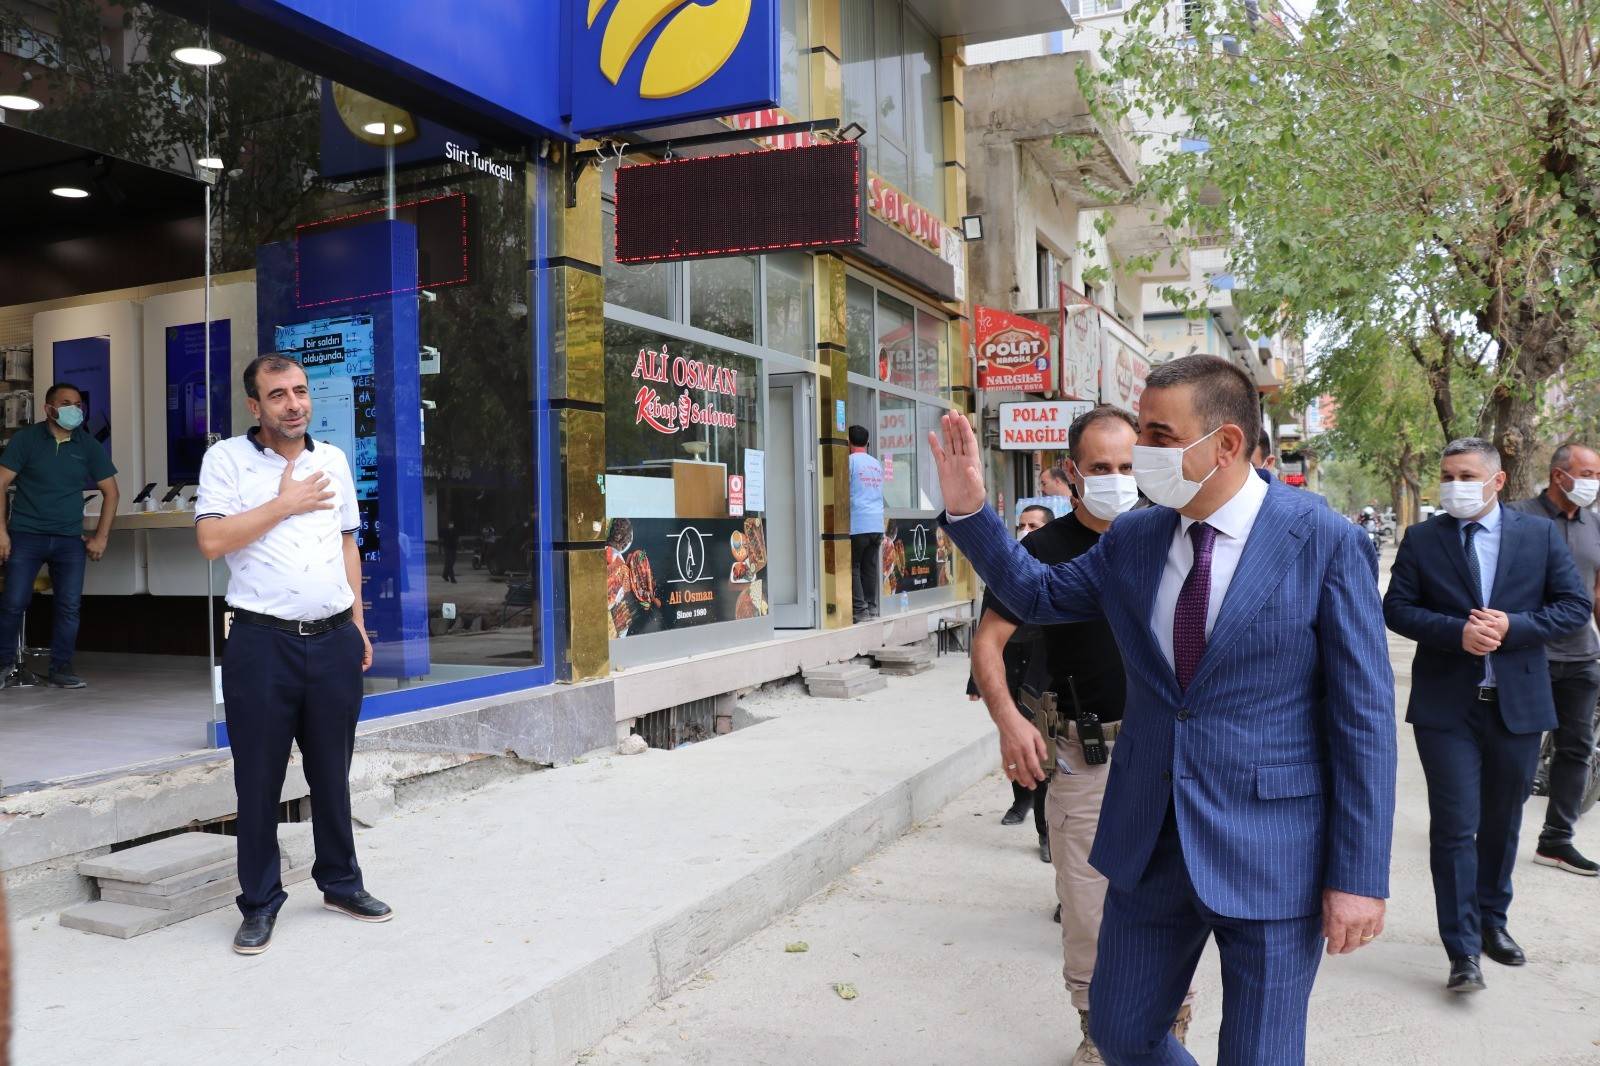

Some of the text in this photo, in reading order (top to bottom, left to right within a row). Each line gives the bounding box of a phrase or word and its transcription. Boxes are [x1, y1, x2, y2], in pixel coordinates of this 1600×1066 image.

[445, 141, 513, 182] Siirt Turkcell
[868, 178, 941, 248] SALONU
[306, 339, 315, 348] bir
[985, 340, 1040, 357] POLAT
[631, 343, 738, 396] ALİ OSMAN
[635, 385, 737, 434] Kebap Salonu
[1012, 407, 1058, 422] POLAT
[1004, 425, 1067, 443] NARGİLE
[669, 590, 714, 605] Ali Osman
[676, 610, 693, 620] Since
